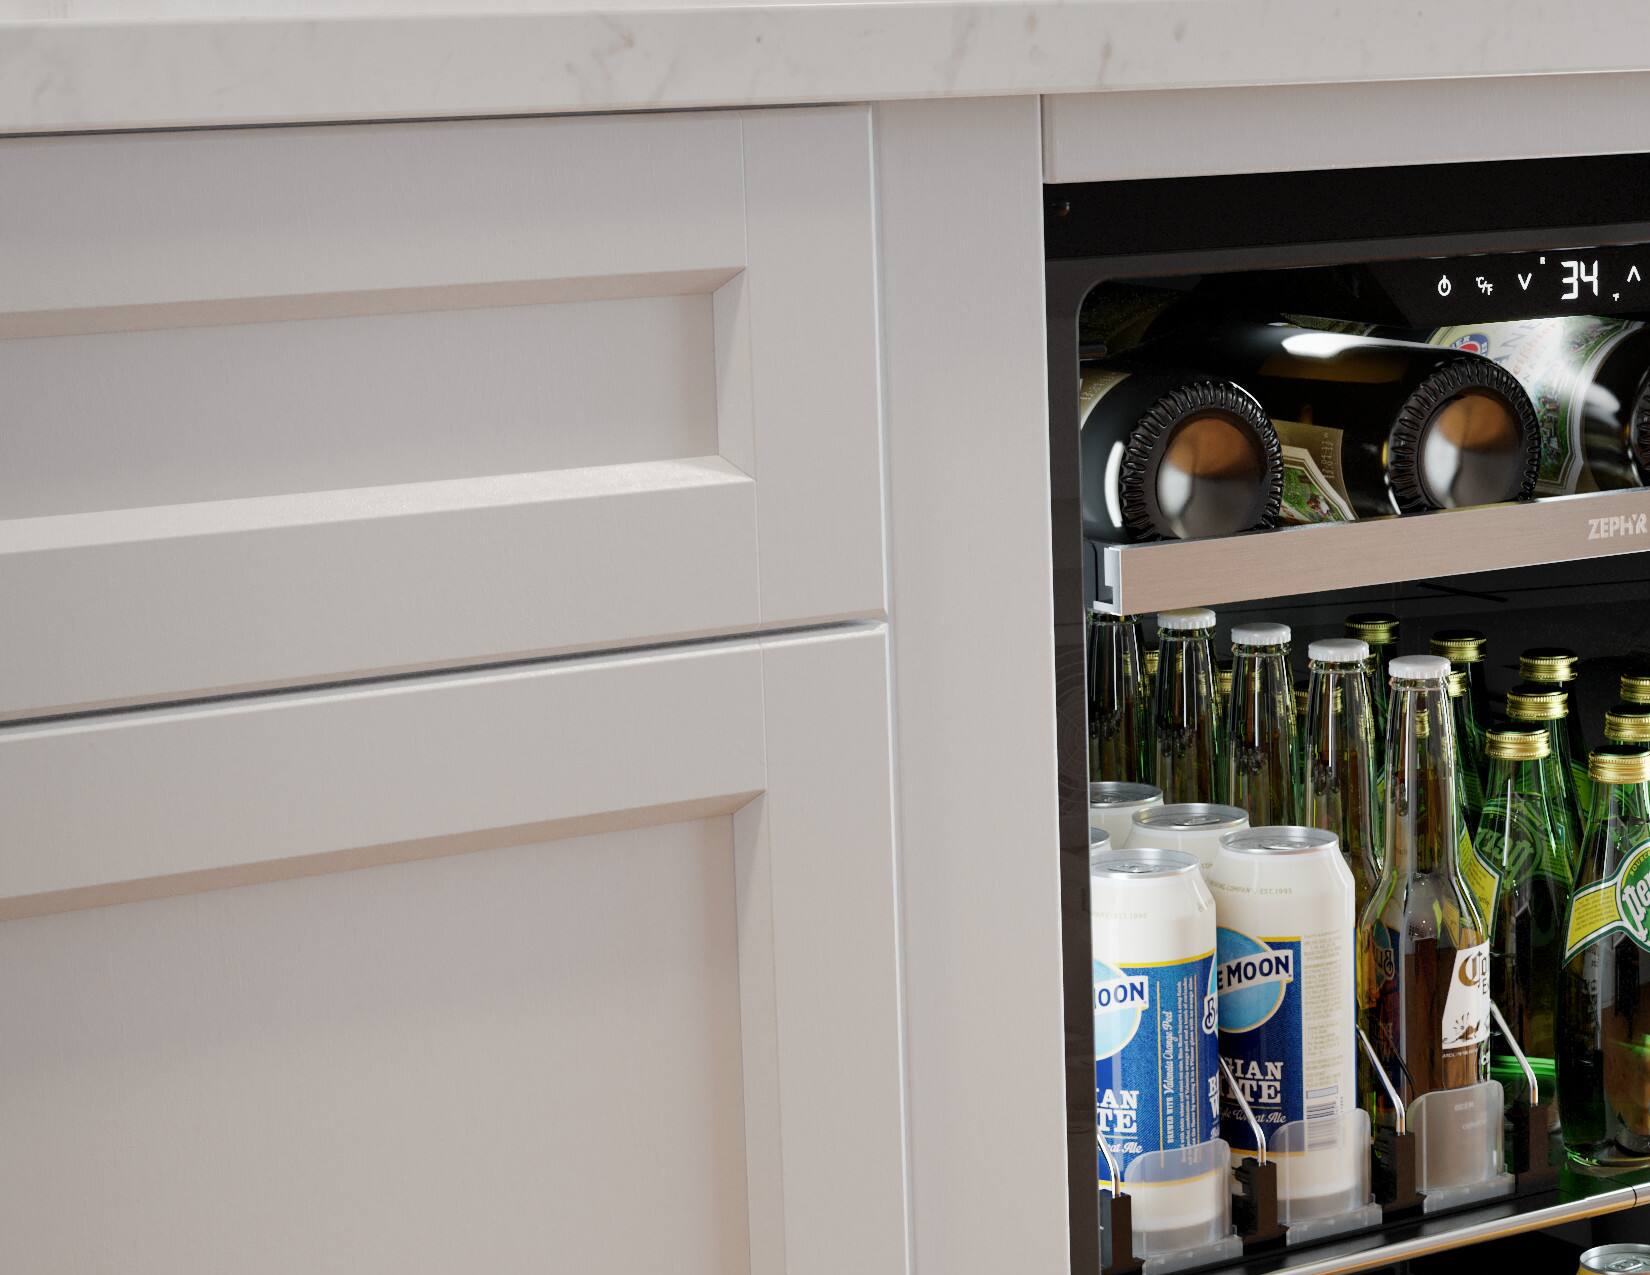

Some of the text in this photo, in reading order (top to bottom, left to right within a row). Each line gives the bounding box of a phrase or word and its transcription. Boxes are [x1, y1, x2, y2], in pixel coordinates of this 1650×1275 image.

[1561, 260, 1598, 300] 34
[1588, 512, 1648, 540] ZEPHYR
[1226, 955, 1289, 988] MOON
[1094, 981, 1145, 1010] OON
[1161, 1010, 1174, 1031] Peel
[1163, 1031, 1178, 1060] Orange
[1163, 1061, 1175, 1095] Valencia
[1097, 1088, 1140, 1110] AN
[1265, 1111, 1287, 1124] Ale
